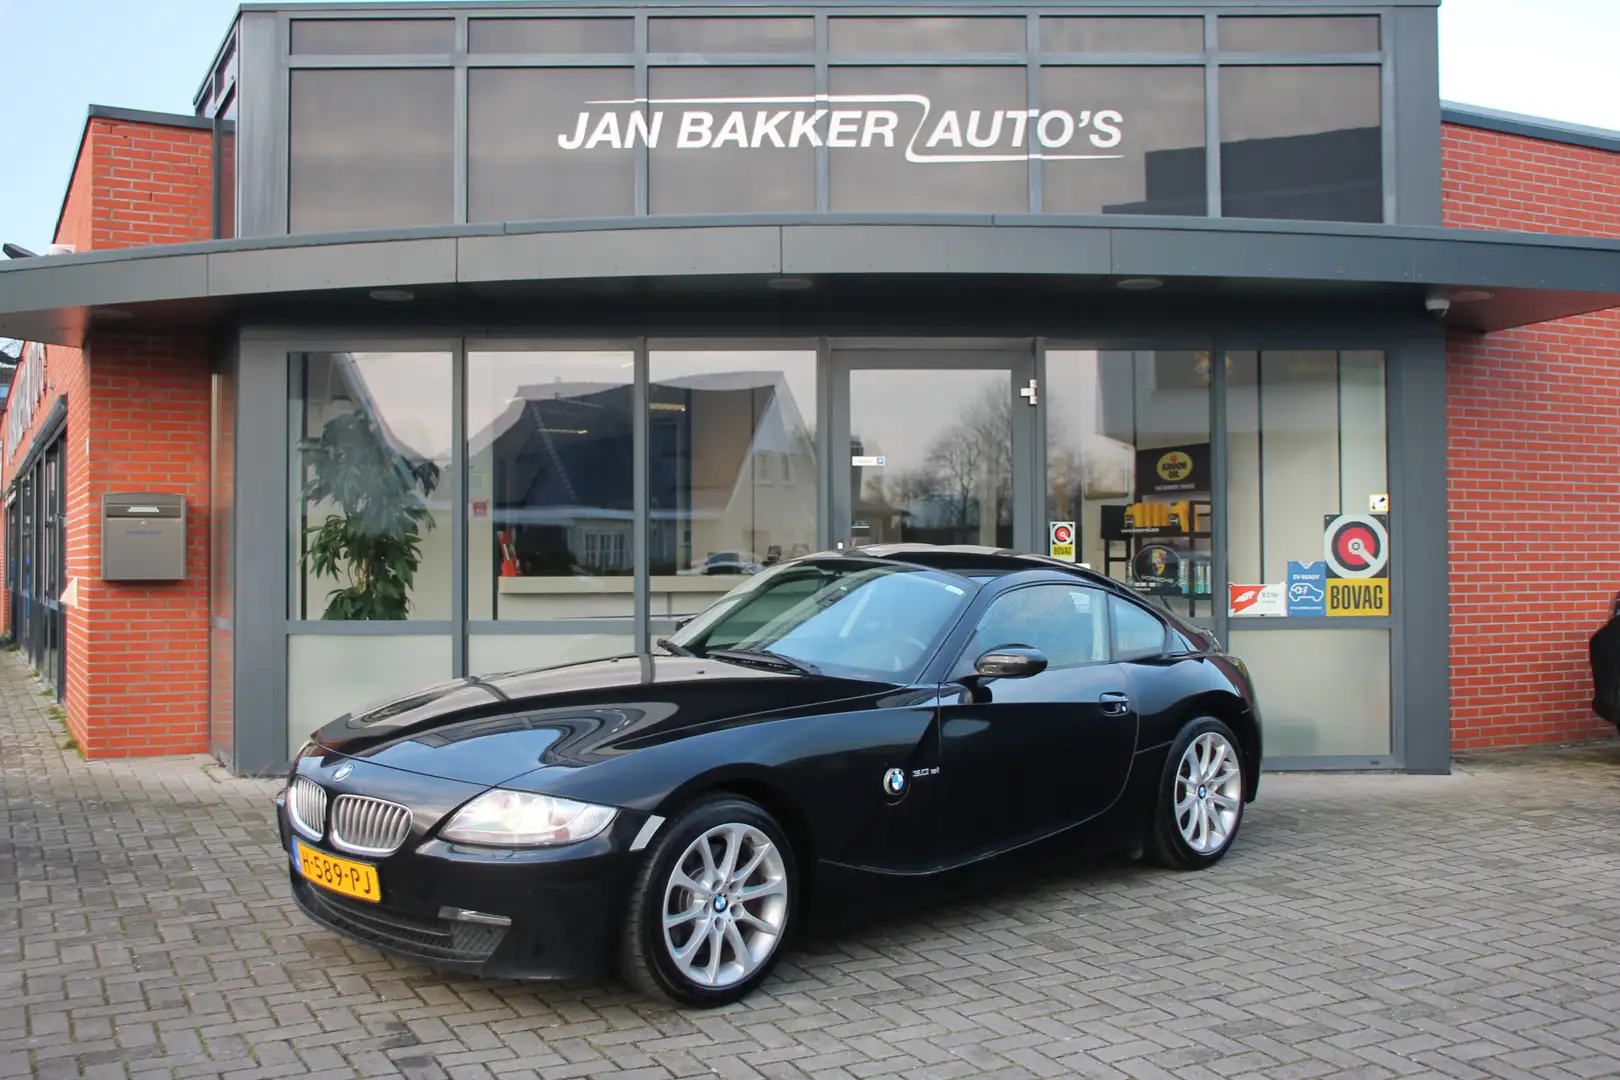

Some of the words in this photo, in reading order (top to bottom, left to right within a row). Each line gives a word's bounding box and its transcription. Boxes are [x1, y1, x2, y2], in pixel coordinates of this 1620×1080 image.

[557, 110, 664, 150] JAN
[676, 108, 898, 149] BAKKER
[925, 109, 1124, 148] AUTO'S
[1053, 546, 1072, 555] BOVAG
[1331, 585, 1383, 609] BOVAG
[301, 850, 372, 895] H-589-PJ
